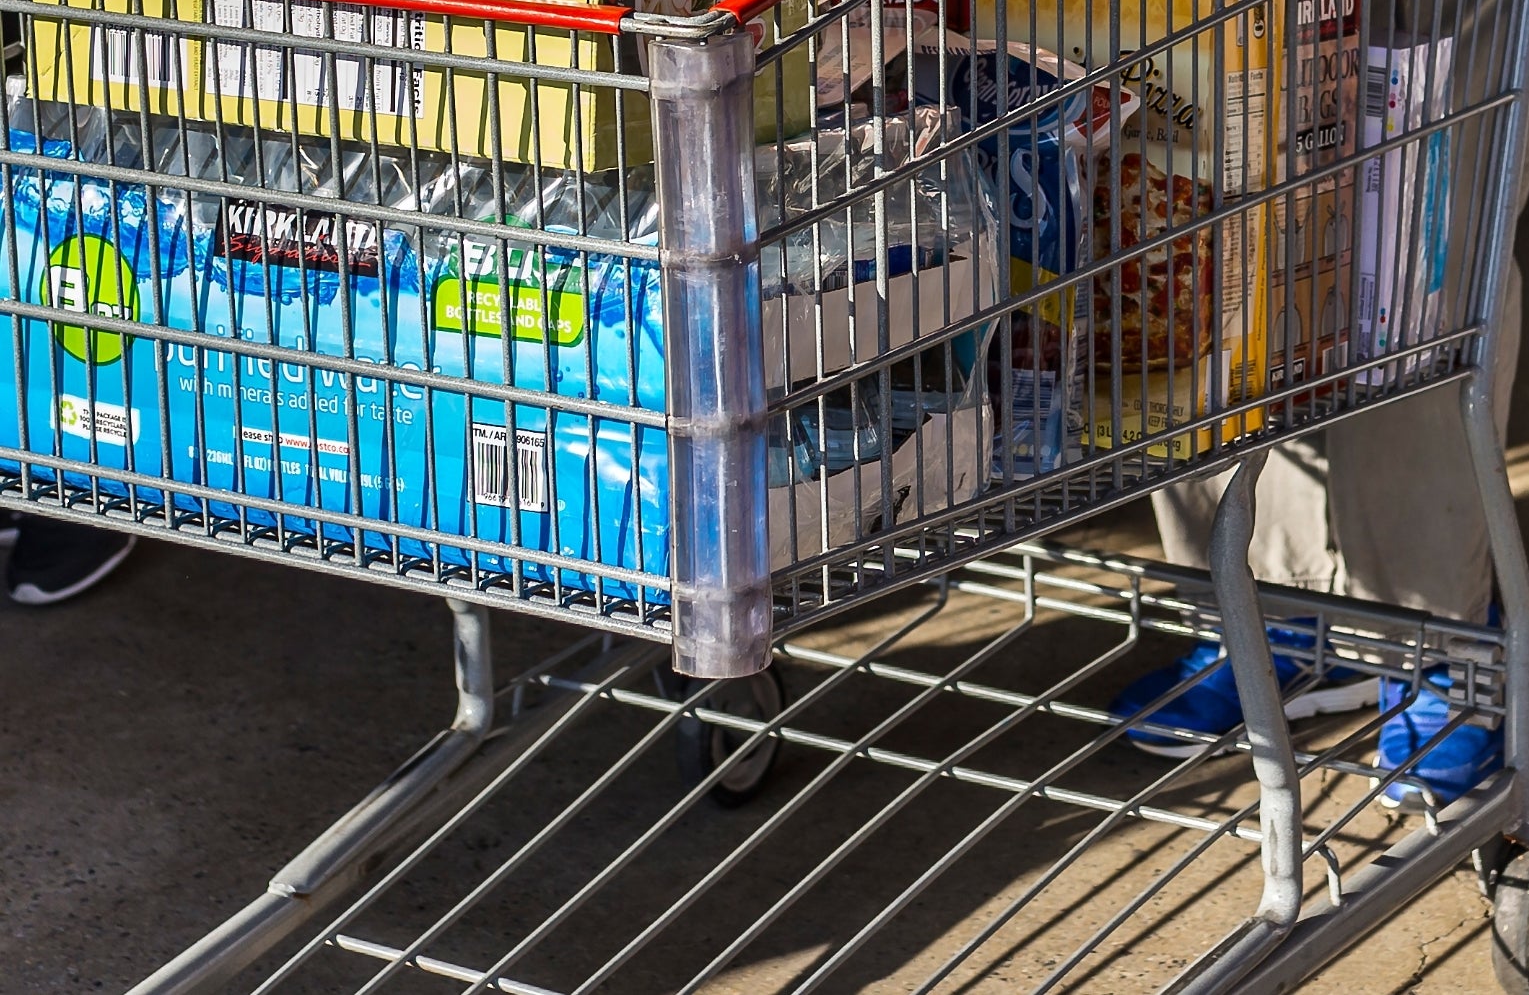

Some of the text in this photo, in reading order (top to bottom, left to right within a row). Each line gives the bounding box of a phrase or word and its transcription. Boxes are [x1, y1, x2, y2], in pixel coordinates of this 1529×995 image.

[414, 12, 425, 51] tritio
[1119, 49, 1202, 130] Pizza
[1298, 88, 1338, 124] BGS
[1124, 125, 1179, 143] Garc, Bail
[1305, 125, 1345, 151] GLLON
[228, 204, 380, 249] KIRKLAND
[467, 291, 542, 312] RECYLABL
[319, 351, 442, 400] waer
[179, 375, 414, 426] wih mneras aded fr tate
[1149, 401, 1184, 417] THOROHLY
[96, 419, 126, 430] RECYCLAB
[473, 428, 488, 438] TM.
[494, 432, 507, 442] AR
[243, 431, 350, 454] ease shp www.ostco.co
